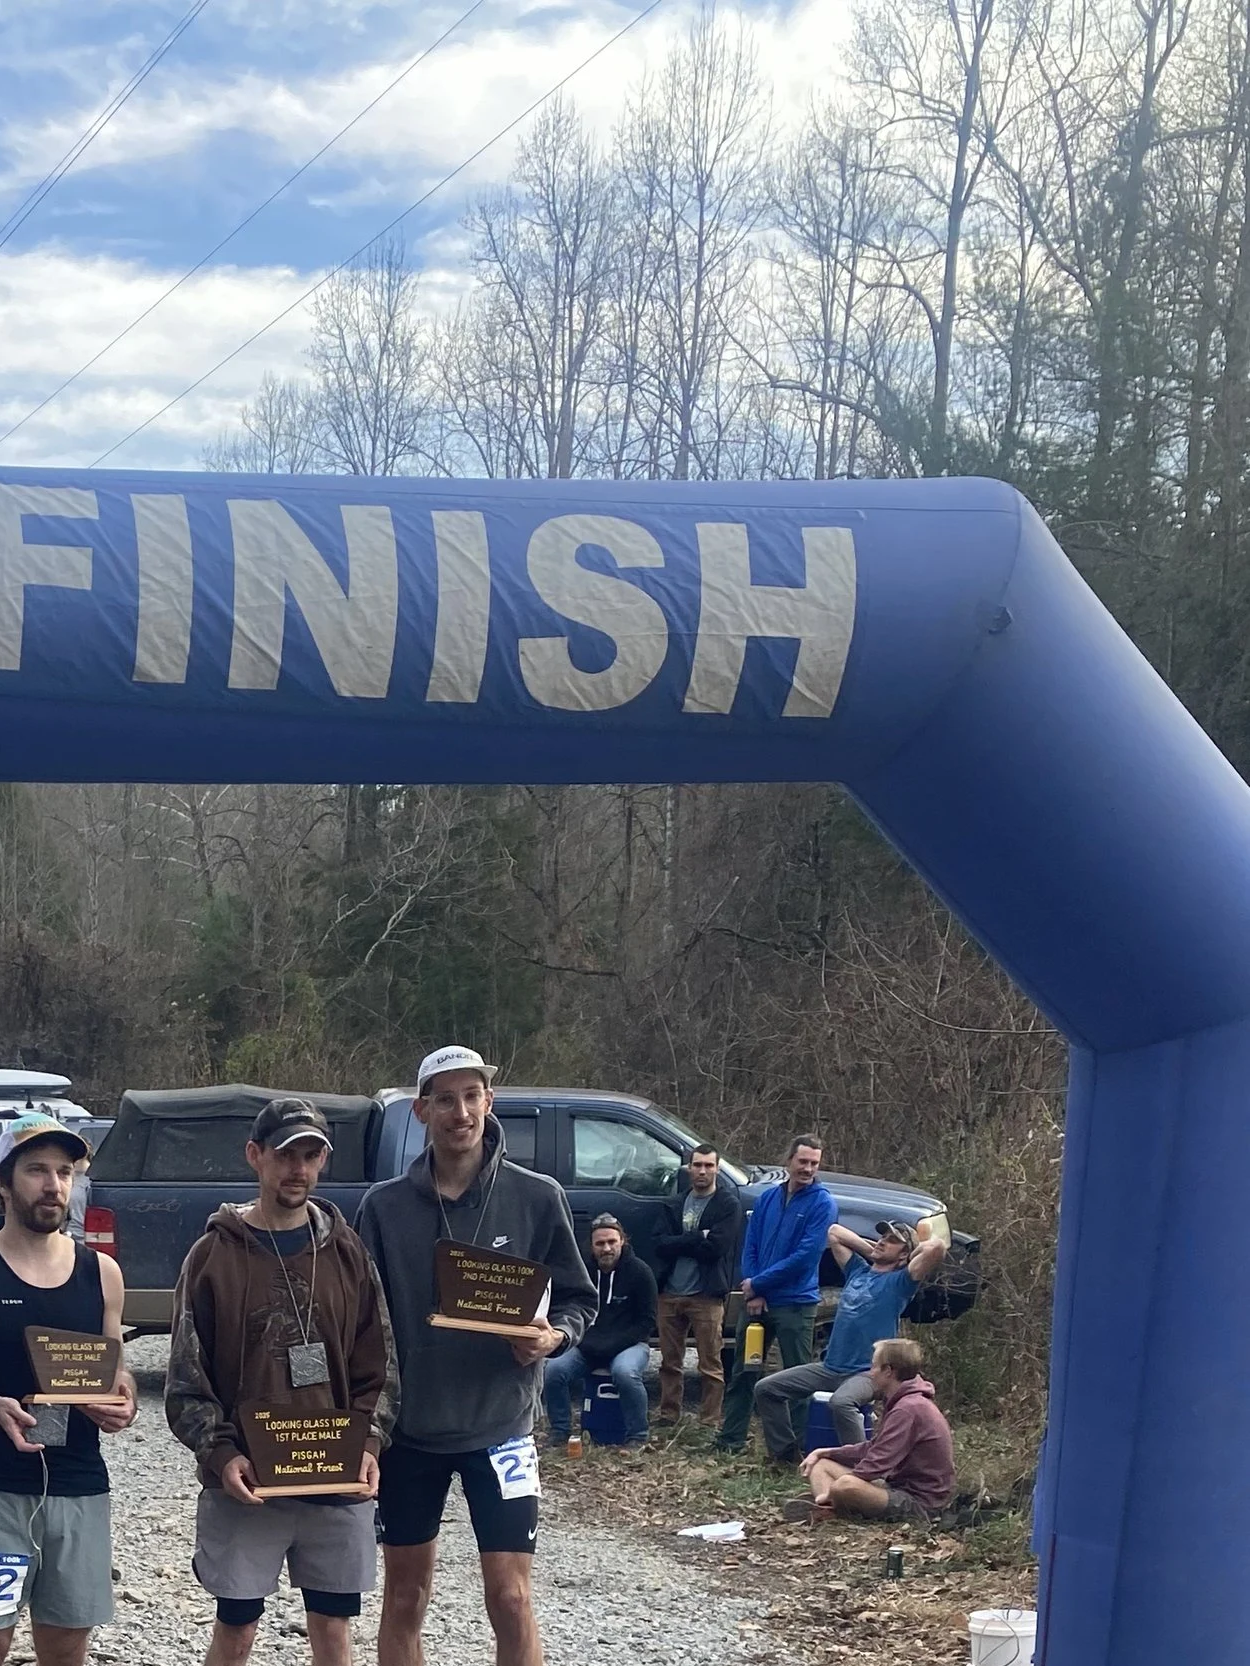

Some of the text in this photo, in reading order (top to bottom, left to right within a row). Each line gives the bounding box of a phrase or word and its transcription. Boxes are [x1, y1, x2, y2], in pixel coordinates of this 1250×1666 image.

[457, 1260, 535, 1276] LOOKING GLASS 100K
[462, 1272, 525, 1287] 2ND PLACE MALE
[474, 1290, 507, 1300] PISGAH
[456, 1299, 521, 1315] National Forest
[45, 1343, 71, 1351] LOOKING
[72, 1343, 92, 1351] GLASS
[64, 1353, 83, 1361] PLACE
[84, 1353, 101, 1361] MALE
[63, 1368, 88, 1376] PISGAH
[51, 1378, 102, 1387] National Forest
[265, 1417, 351, 1431] LOOKING GLASS 100K
[275, 1430, 342, 1442] 1ST PLACE MALE
[291, 1450, 326, 1460] PISGAH
[274, 1462, 344, 1475] National Forest
